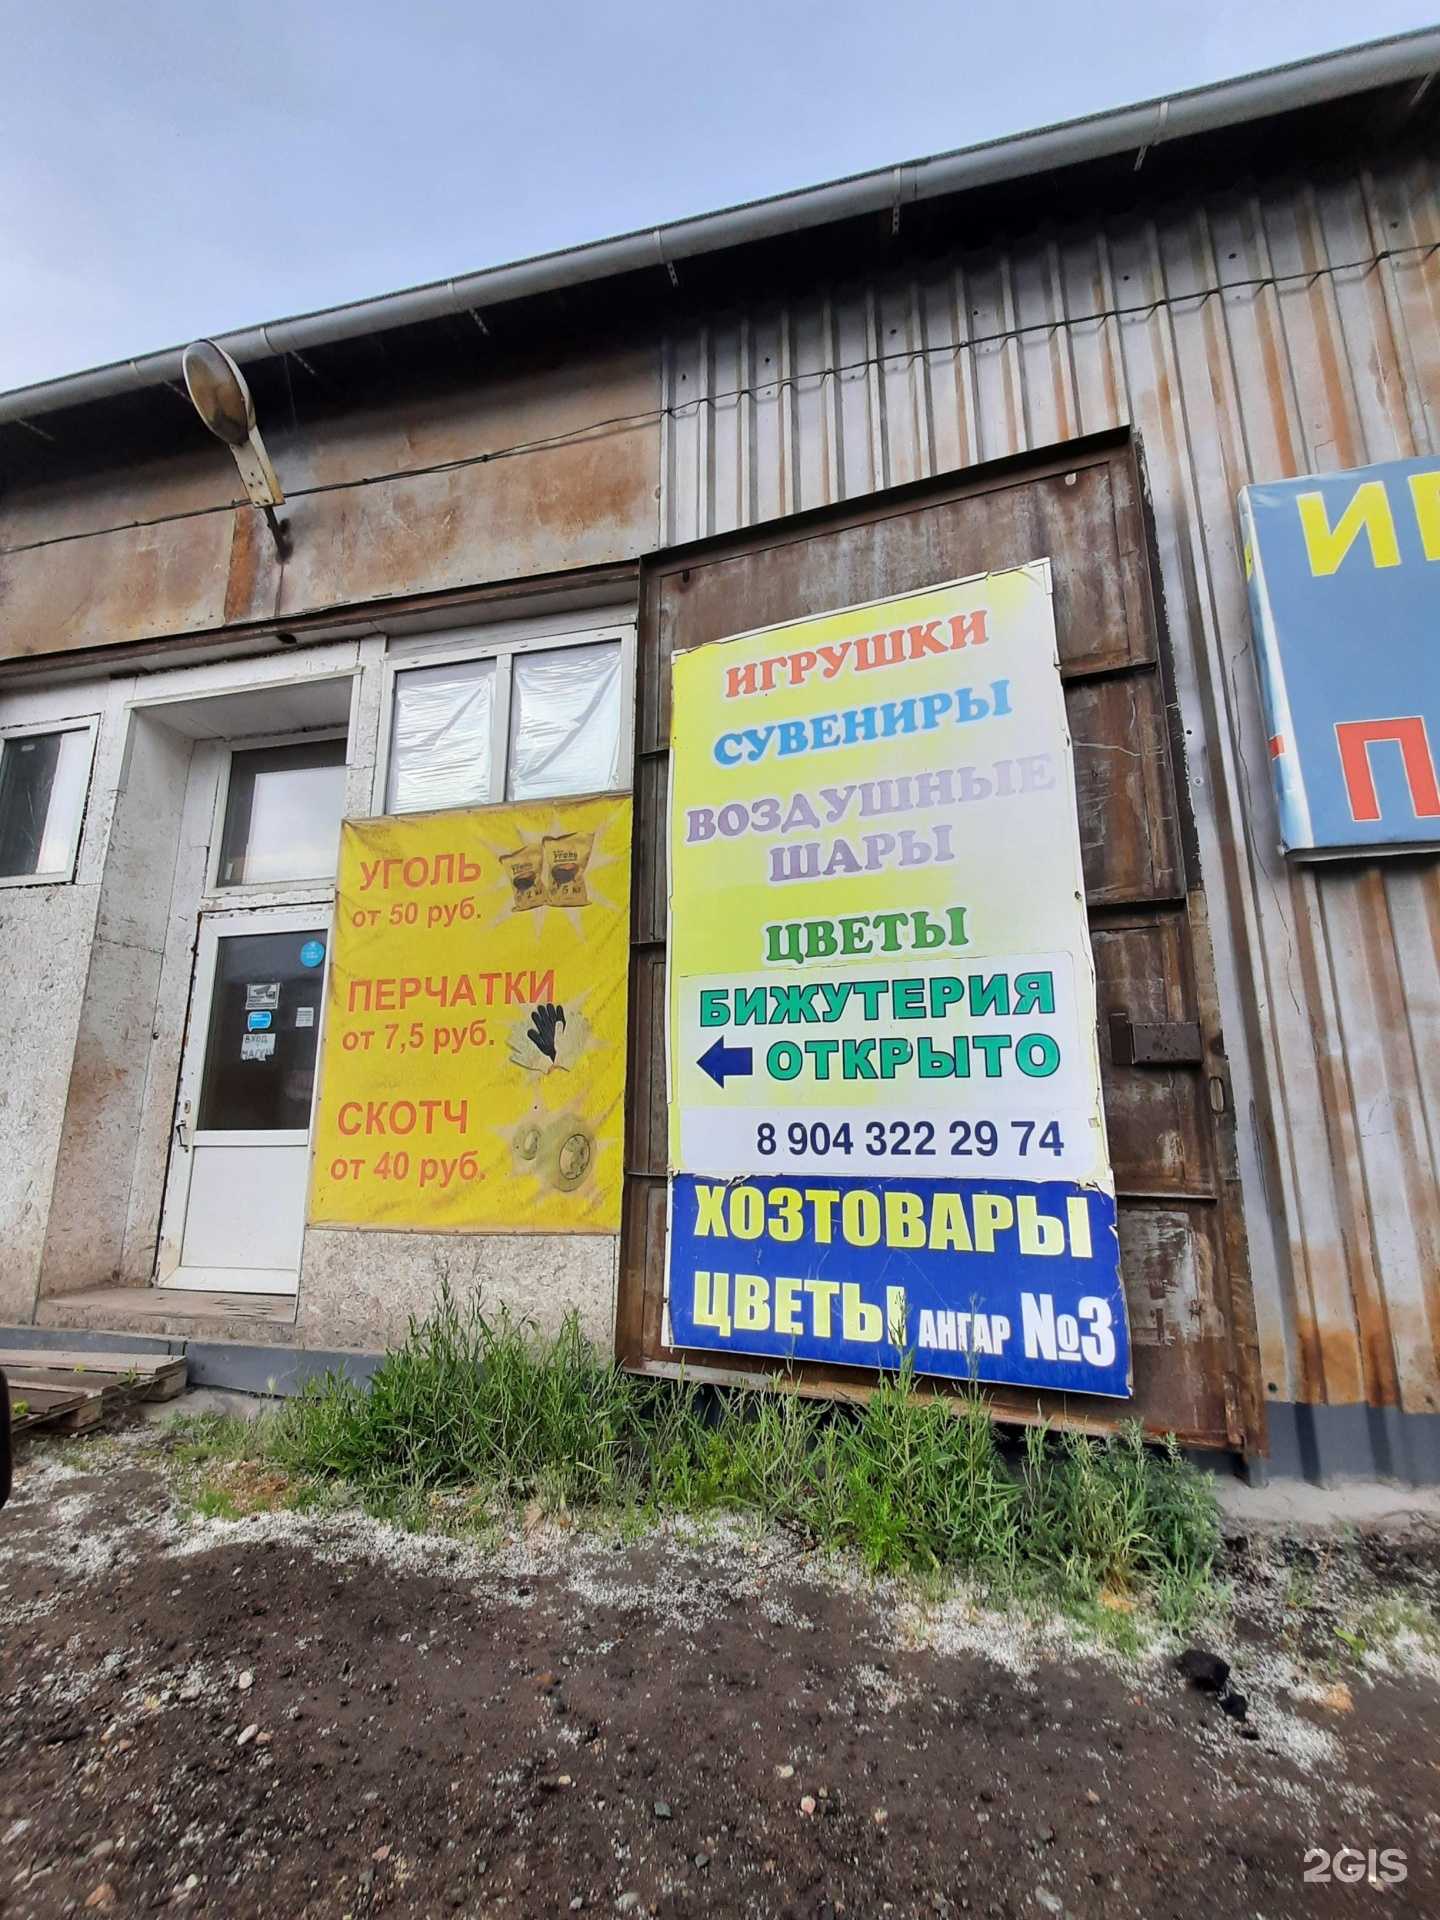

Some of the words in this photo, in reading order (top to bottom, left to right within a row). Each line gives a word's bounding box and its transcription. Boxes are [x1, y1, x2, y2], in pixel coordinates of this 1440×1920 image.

[1296, 471, 1440, 577] И
[725, 610, 989, 698] ИГРУШКИ
[713, 680, 1013, 766] СУВЕНИРЫ
[686, 754, 1056, 843] ВОЗДУШНЫЕ
[359, 852, 481, 891] УГОЛЬ
[769, 825, 955, 882] ШАРЫ
[352, 909, 380, 928] от
[389, 902, 418, 925] 50
[427, 896, 481, 929] руб.
[766, 907, 969, 964] ЦВЕТЫ
[347, 969, 556, 1012] ПЕРЧАТКИ
[699, 971, 1055, 1027] БИЖУТЕРИЯ
[342, 1031, 374, 1052] от
[384, 1022, 424, 1054] 7,5
[433, 1018, 495, 1054] руб.
[766, 1033, 1061, 1080] ОТКРЫТО
[337, 1099, 468, 1136] СКОТЧ
[756, 1122, 776, 1155] 8
[787, 1122, 854, 1156] 904
[865, 1121, 936, 1156] 322
[948, 1120, 999, 1156] 29
[1010, 1120, 1064, 1157] 74
[330, 1160, 366, 1181] от
[373, 1151, 409, 1178] 40
[418, 1151, 487, 1188] руб.
[693, 1185, 1093, 1258] ХОЗТОВАРЫ
[693, 1271, 907, 1346] ЦВЕТЫ
[918, 1308, 1011, 1355] АНГАР
[1020, 1292, 1116, 1368] №3
